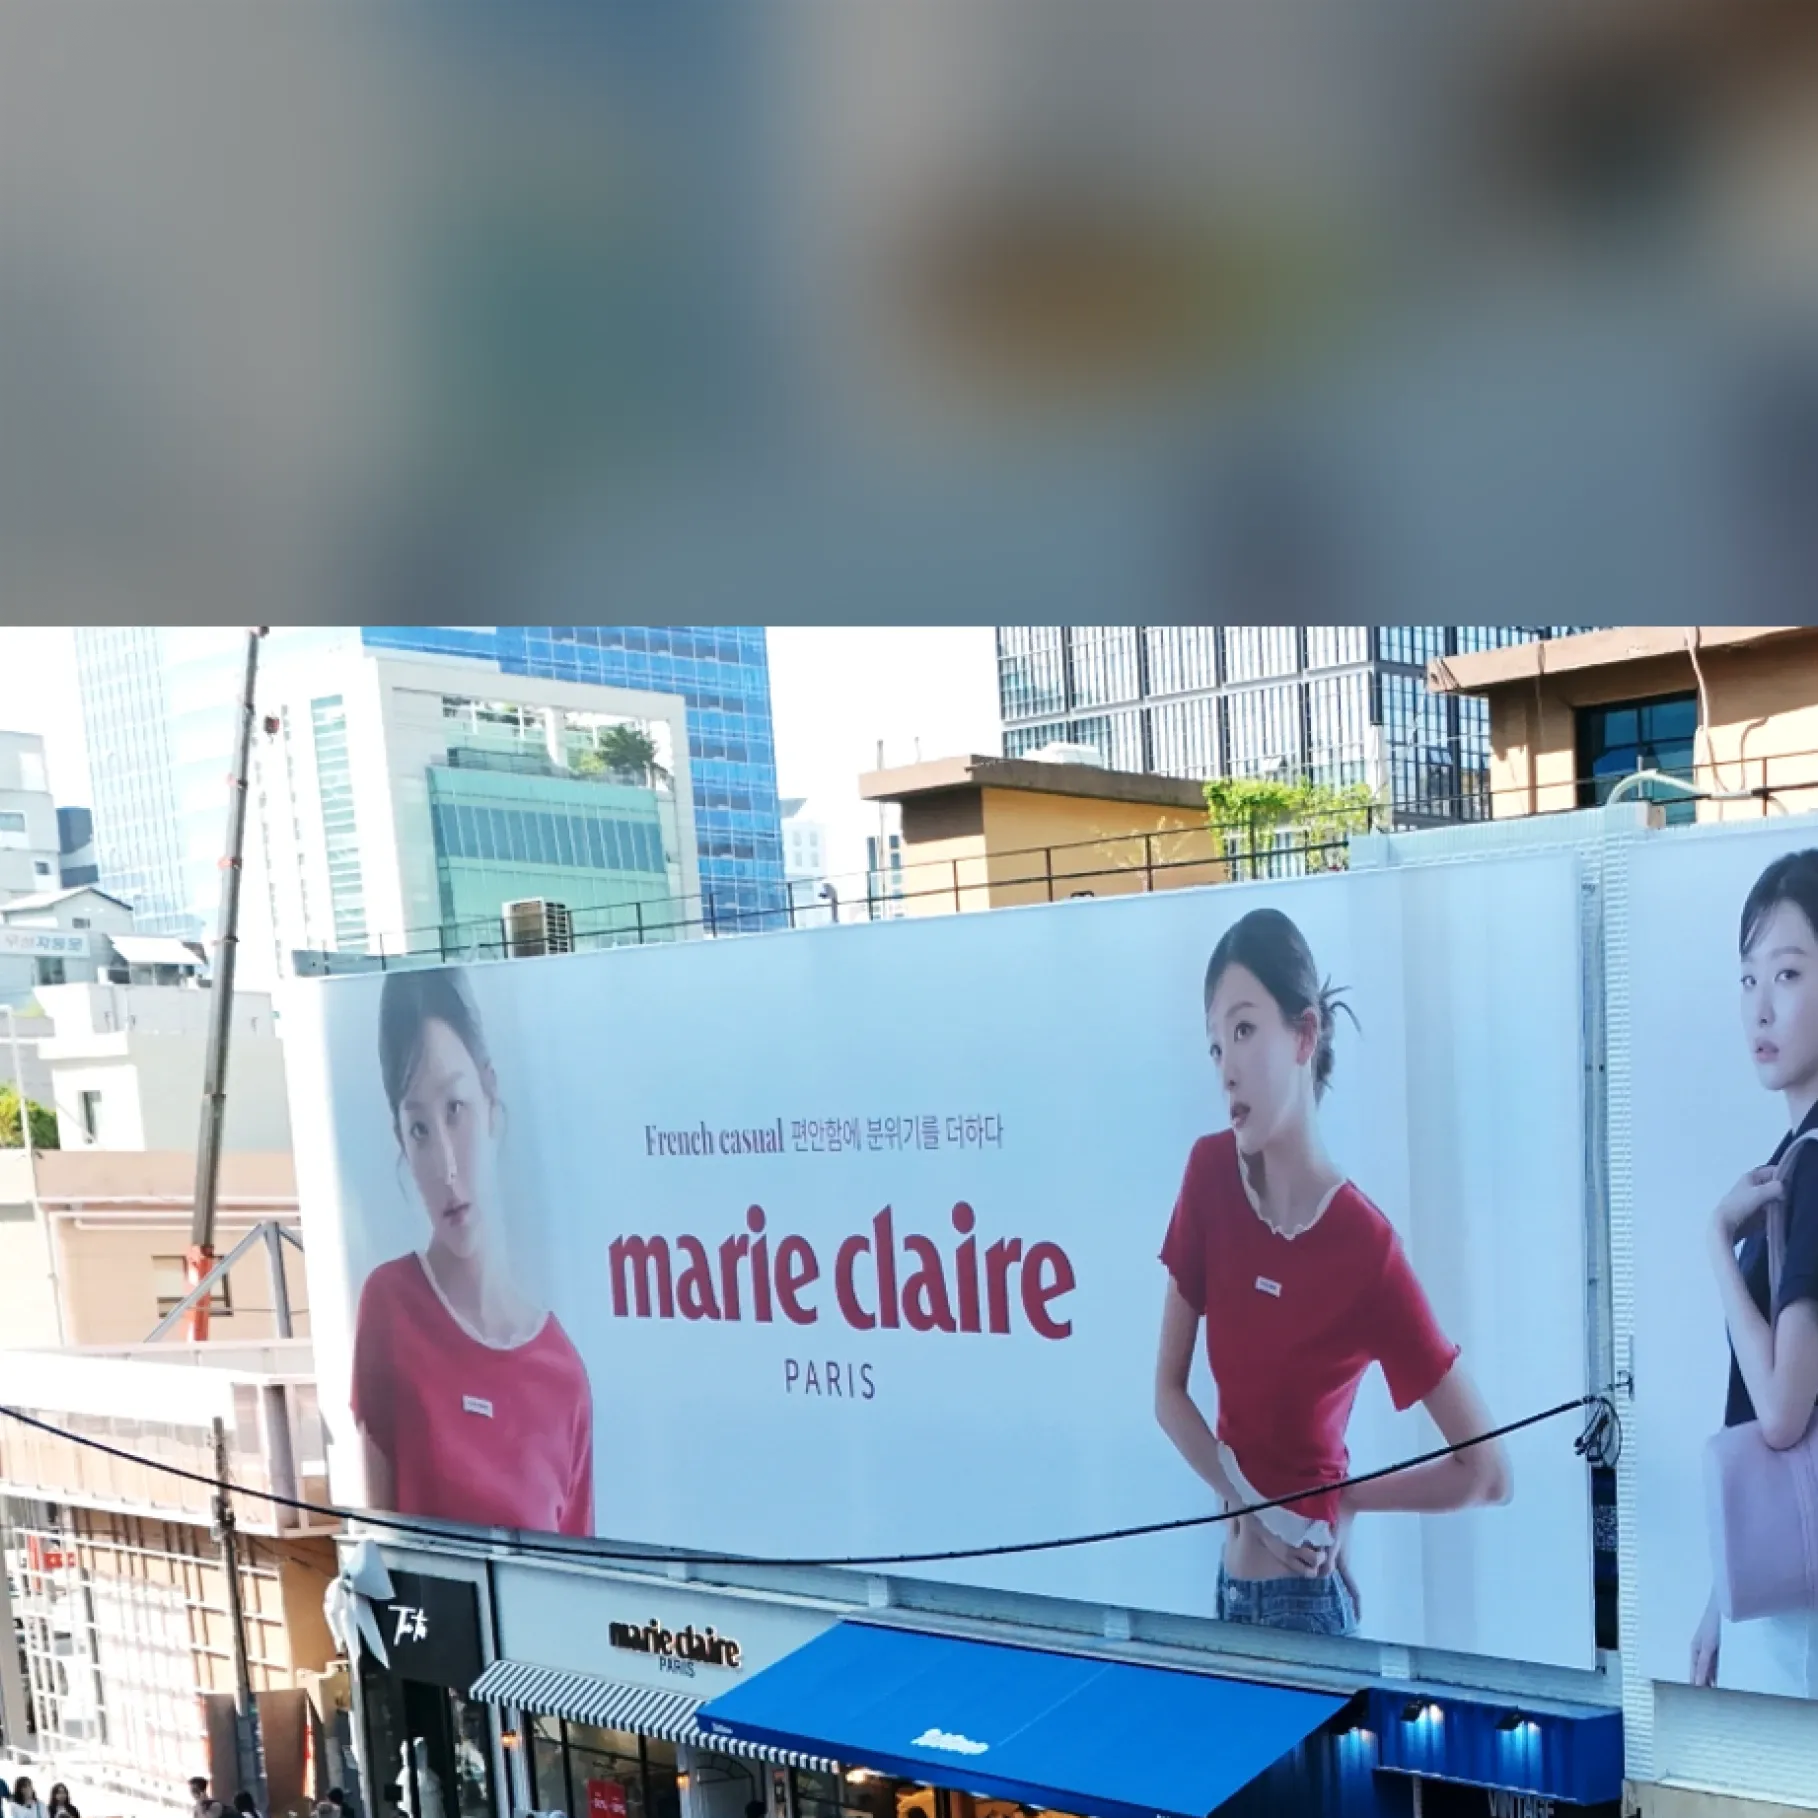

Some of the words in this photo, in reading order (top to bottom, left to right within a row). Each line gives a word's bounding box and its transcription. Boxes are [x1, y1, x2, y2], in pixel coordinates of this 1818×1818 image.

[645, 1121, 714, 1156] French
[718, 1117, 785, 1155] casual
[790, 1118, 861, 1152] 편안함에
[867, 1115, 940, 1150] 분위기를
[947, 1113, 1004, 1150] 더하다
[608, 1203, 820, 1325] marie
[835, 1200, 1076, 1340] claire
[784, 1357, 876, 1400] PARIS
[608, 1618, 673, 1655] marie
[675, 1624, 742, 1668] claire
